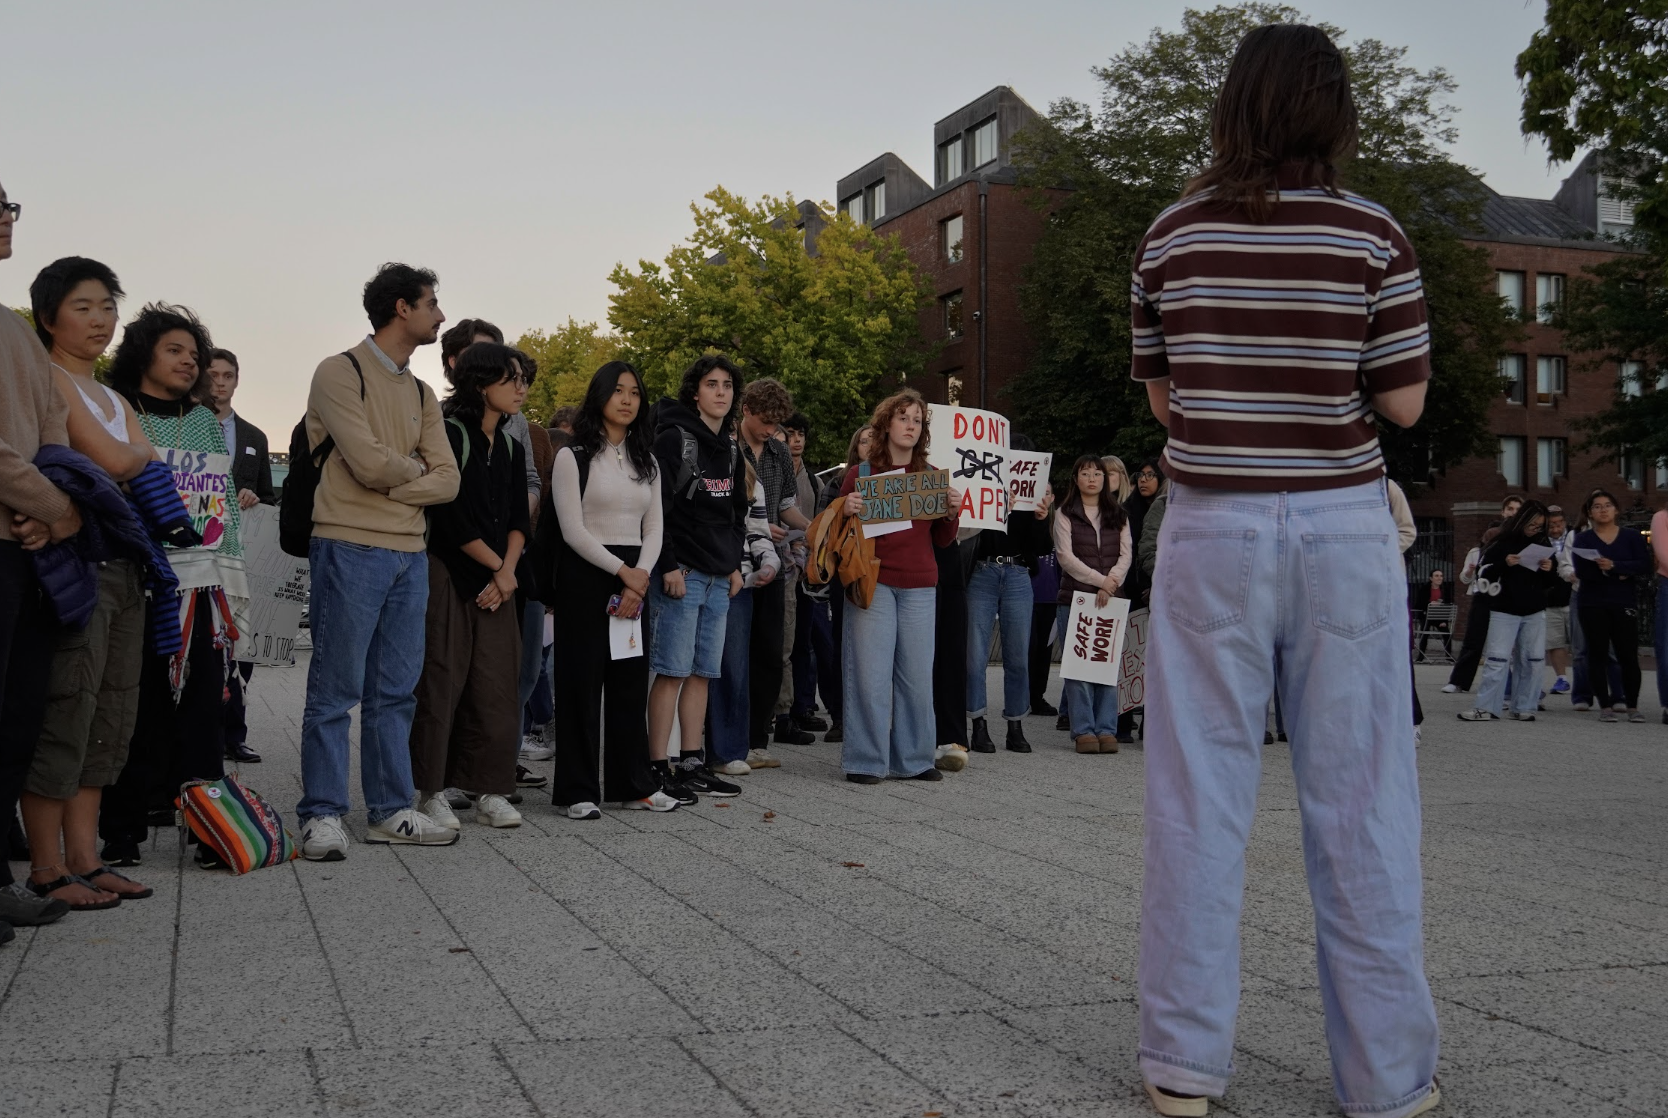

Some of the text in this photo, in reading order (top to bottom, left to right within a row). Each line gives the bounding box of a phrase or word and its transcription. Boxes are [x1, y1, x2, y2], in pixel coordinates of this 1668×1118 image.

[954, 412, 1006, 448] DON'T
[167, 449, 208, 473] LOS
[1009, 459, 1040, 477] AFE
[703, 476, 734, 491] RIM
[856, 473, 949, 498] WE ARE ALL
[1009, 479, 1037, 498] ORK
[857, 492, 948, 521] JANE DOE
[263, 635, 273, 658] TO
[1073, 612, 1093, 660] SAFE
[1090, 616, 1114, 662] WORK
